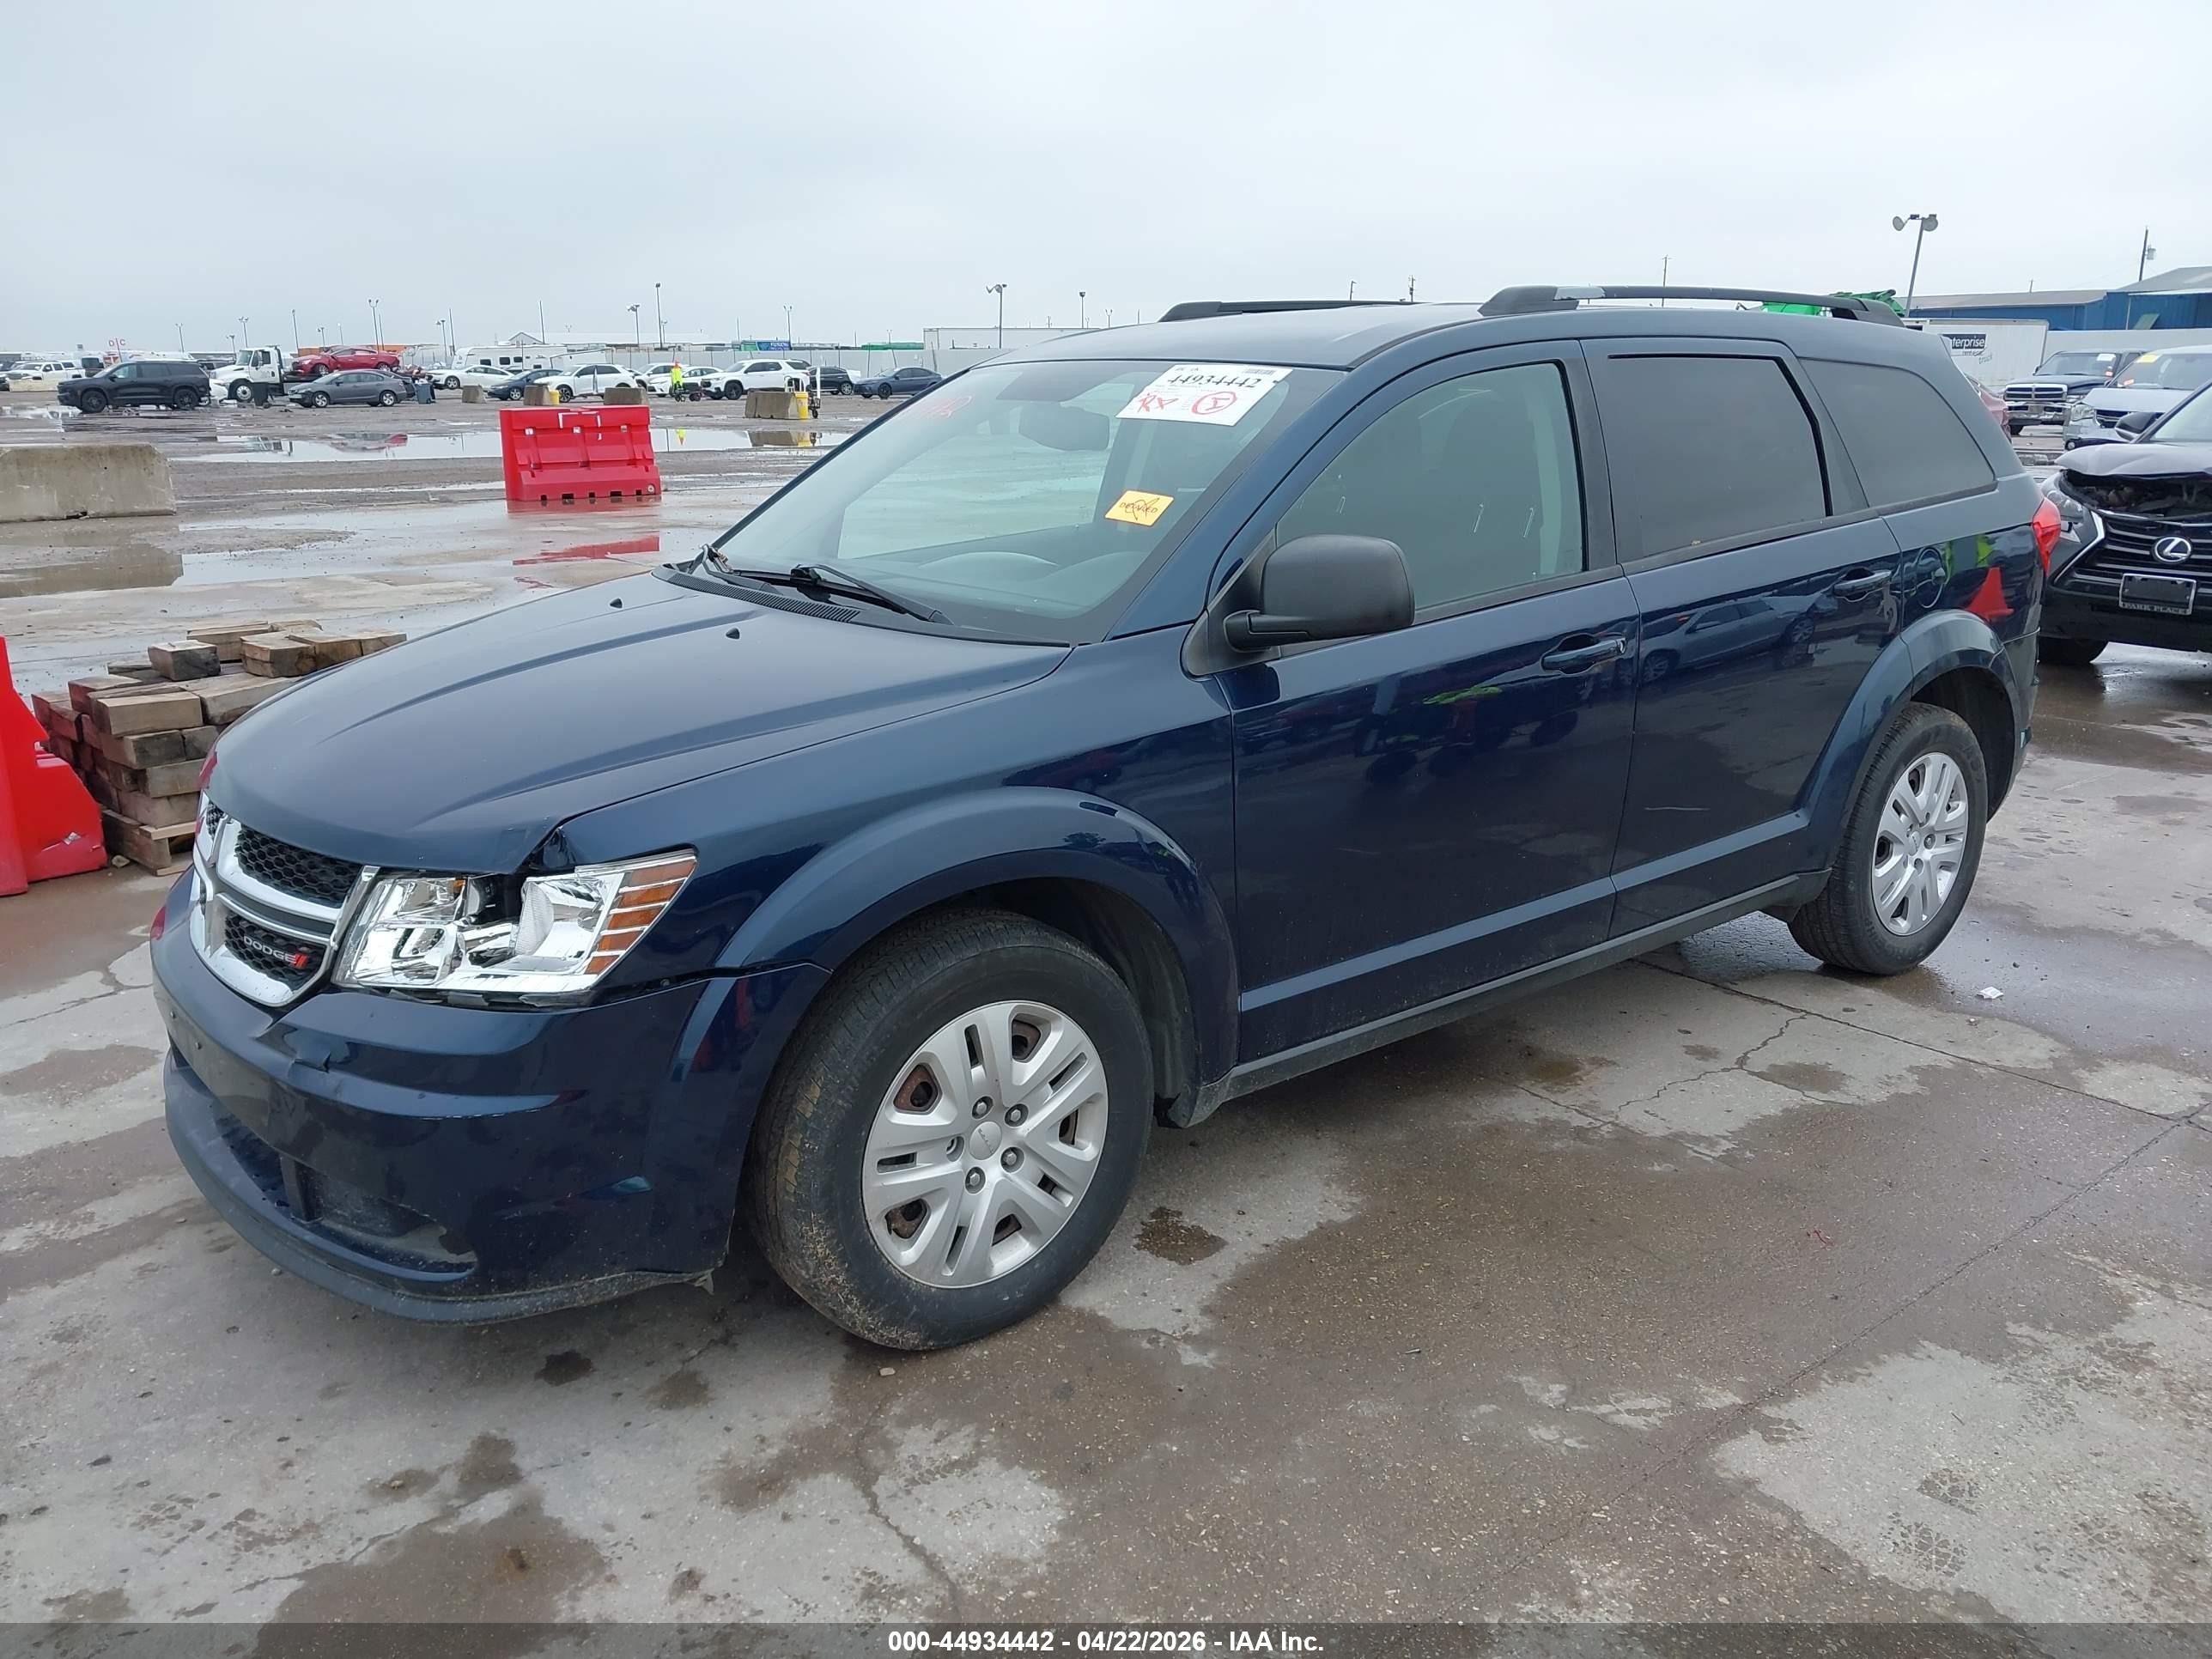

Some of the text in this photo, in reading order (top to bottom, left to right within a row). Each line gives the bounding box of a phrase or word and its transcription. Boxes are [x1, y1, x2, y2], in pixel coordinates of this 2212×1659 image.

[1952, 335, 1985, 349] terprise
[1167, 374, 1262, 388] 44934442
[243, 935, 297, 964] DODGE
